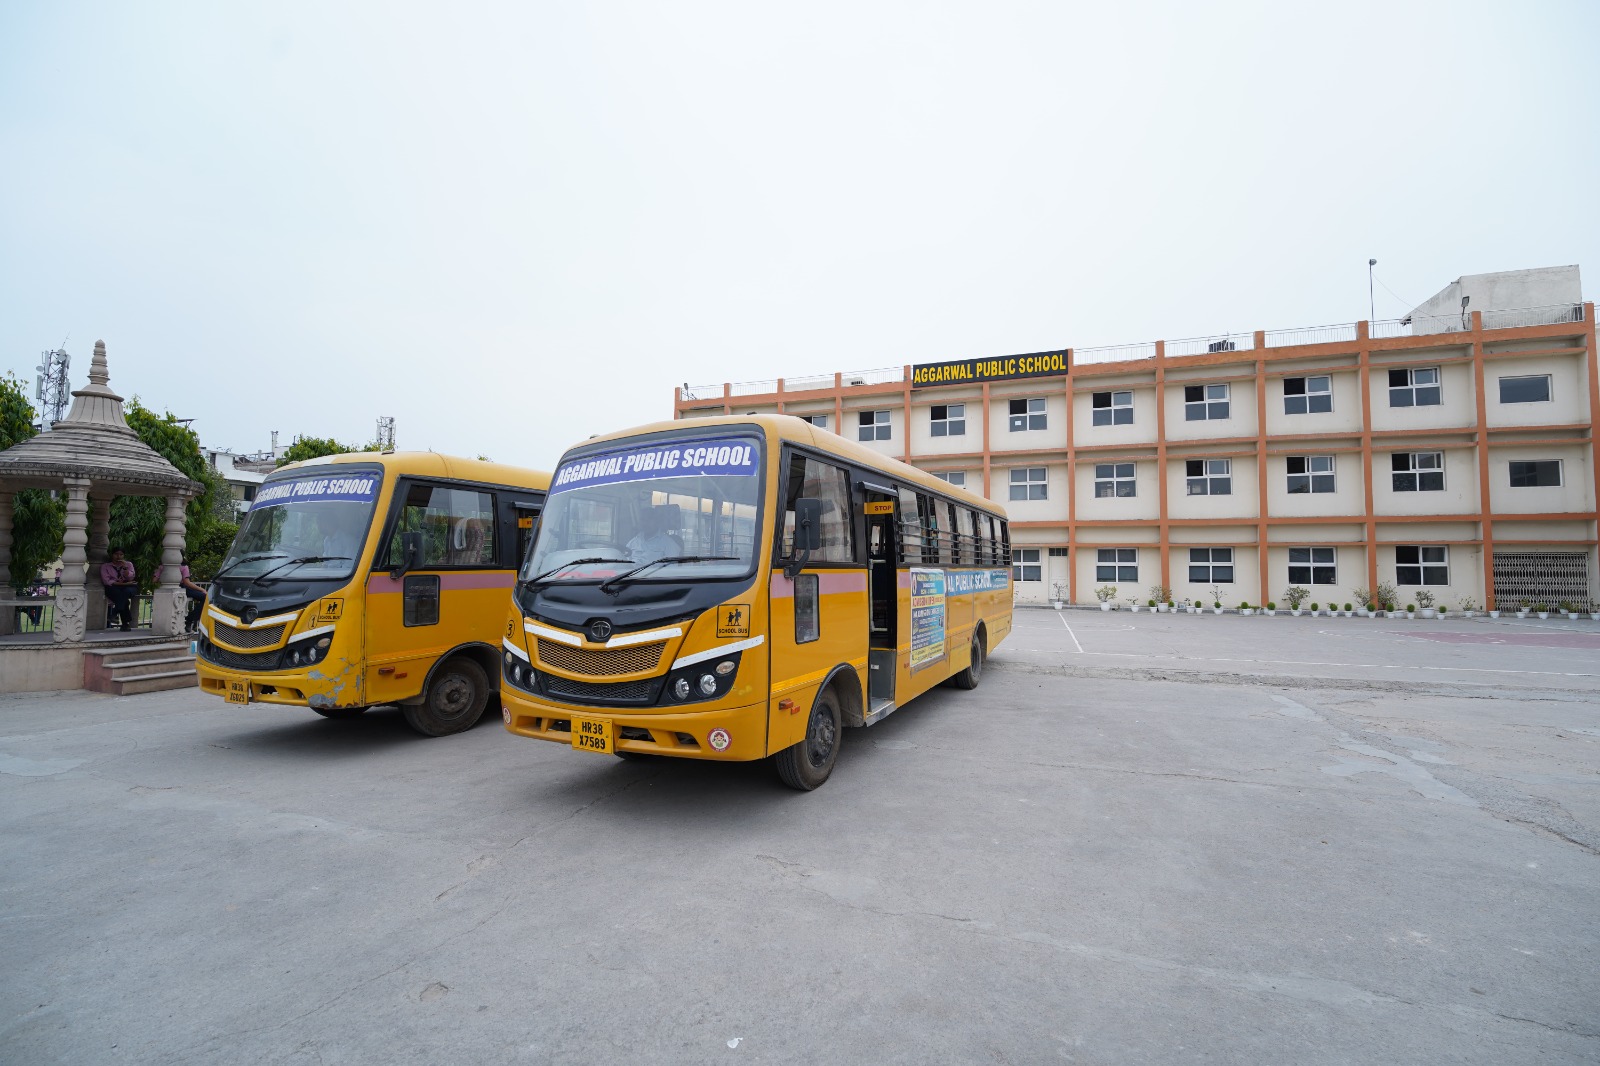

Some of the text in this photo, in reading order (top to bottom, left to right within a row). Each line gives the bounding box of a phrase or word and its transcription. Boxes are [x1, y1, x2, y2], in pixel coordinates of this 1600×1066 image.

[913, 354, 1067, 384] AGGARWAL PUBLIC SCHOOL
[556, 446, 752, 486] AGGARWAL PUBLIC SCHOOL
[291, 480, 328, 496] PUBLIC
[327, 479, 374, 494] SCHOOL
[955, 574, 974, 591] PUBLIC
[975, 573, 992, 590] SCHOOL
[582, 721, 603, 735] HR38
[579, 735, 606, 750] X7589
